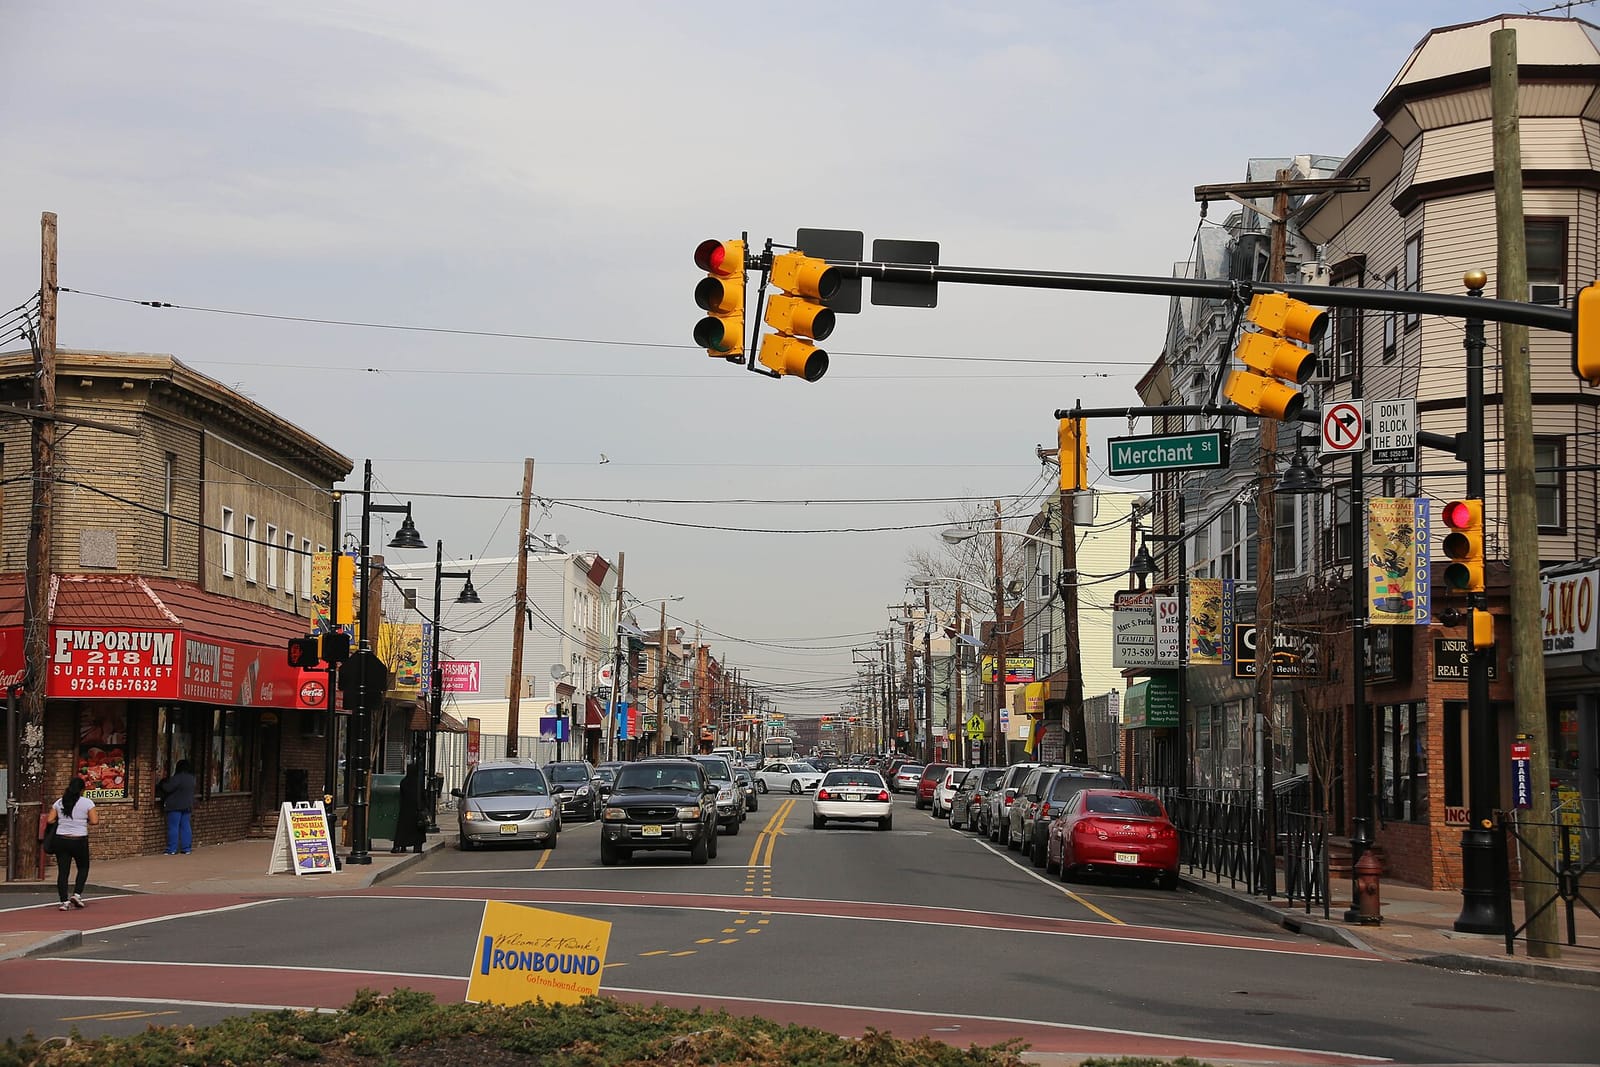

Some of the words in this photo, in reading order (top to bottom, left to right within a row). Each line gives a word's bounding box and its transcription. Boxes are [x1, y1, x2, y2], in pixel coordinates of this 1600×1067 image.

[1381, 404, 1406, 417] DON'T
[1380, 419, 1407, 432] BLOCK
[1375, 436, 1391, 448] THE
[1396, 434, 1413, 447] BOX
[1119, 443, 1193, 464] Merchant
[1201, 440, 1212, 451] St
[1416, 504, 1428, 620] IRONBOUND
[1120, 596, 1143, 605] PHONE
[1117, 622, 1131, 632] Marc
[1223, 583, 1232, 661] IRONBOUND
[54, 629, 175, 666] EMPORIUM
[87, 651, 140, 665] 218
[184, 639, 221, 683] EMPORIUM
[422, 626, 430, 689] IRONBOUND
[53, 665, 173, 678] SUPERMARKET
[193, 667, 210, 683] 218
[446, 663, 469, 676] FASHION
[1437, 665, 1460, 677] REAL
[71, 678, 158, 692] 973-465-7632
[184, 684, 219, 700] SUPERMARKET
[301, 688, 325, 698] Coca-Cola
[1517, 760, 1527, 805] BARAKA
[86, 790, 125, 799] REMESAS
[494, 932, 540, 946] Welcome
[541, 937, 553, 947] to
[555, 937, 600, 951] Newark's
[481, 935, 600, 975] IRONBOUND
